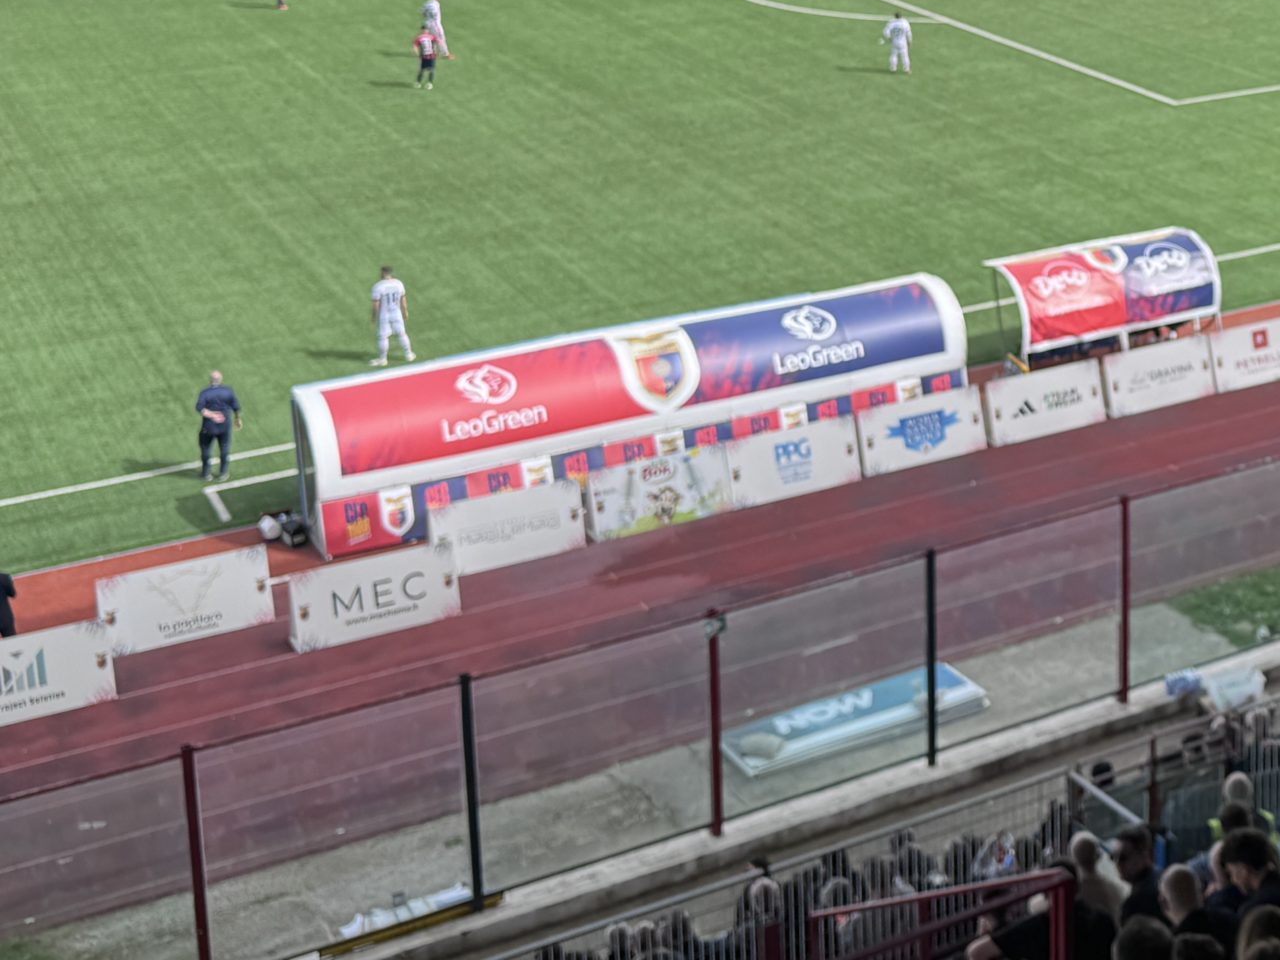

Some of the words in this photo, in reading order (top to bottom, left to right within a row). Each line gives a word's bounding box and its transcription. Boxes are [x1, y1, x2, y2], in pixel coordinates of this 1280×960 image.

[772, 341, 865, 375] LeoGreen
[442, 405, 548, 443] LeoGreen
[331, 571, 427, 618] MEC
